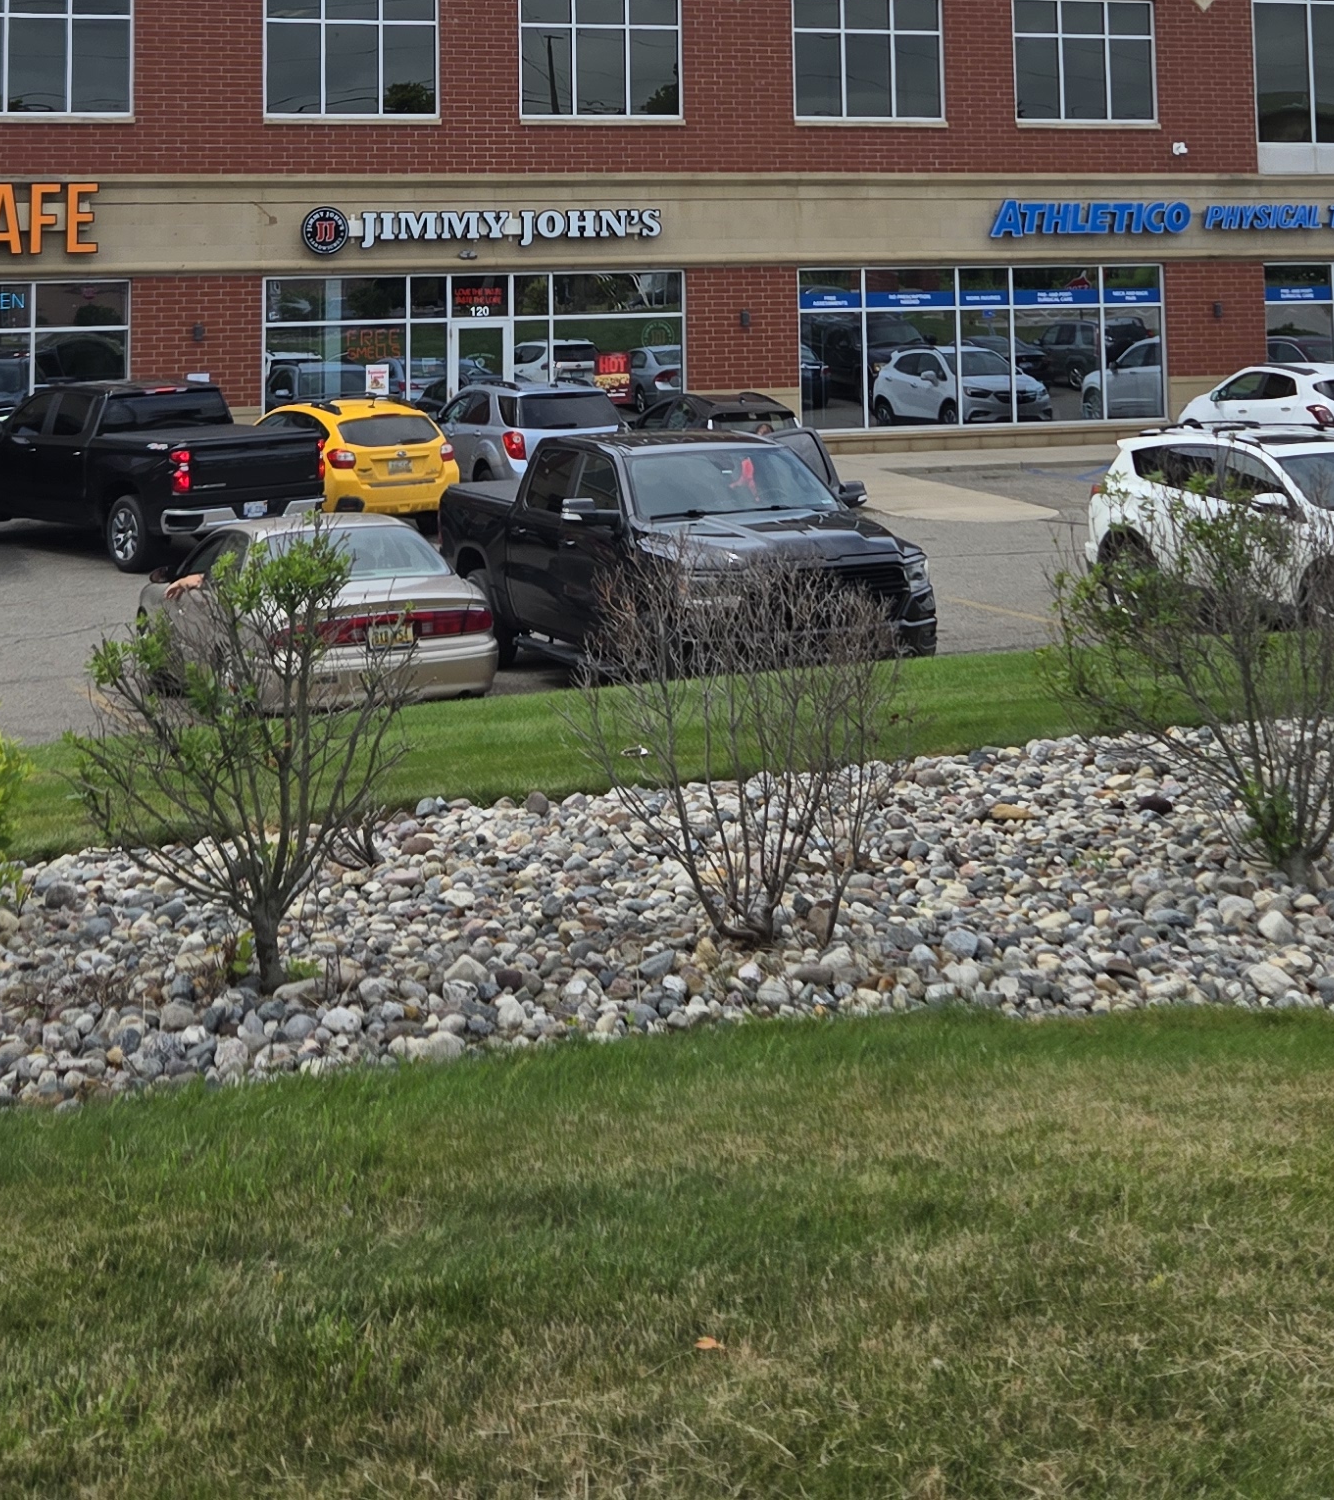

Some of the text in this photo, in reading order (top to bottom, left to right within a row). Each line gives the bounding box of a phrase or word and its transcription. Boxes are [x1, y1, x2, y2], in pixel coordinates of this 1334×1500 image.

[990, 199, 1192, 237] ATHLETICO
[1204, 204, 1322, 230] PHYSICAL
[316, 221, 336, 242] JJ
[360, 210, 510, 249] JIMMY
[470, 305, 490, 317] 120
[346, 328, 401, 346] FREE
[347, 343, 401, 360] SMELLS
[598, 355, 627, 373] HOT
